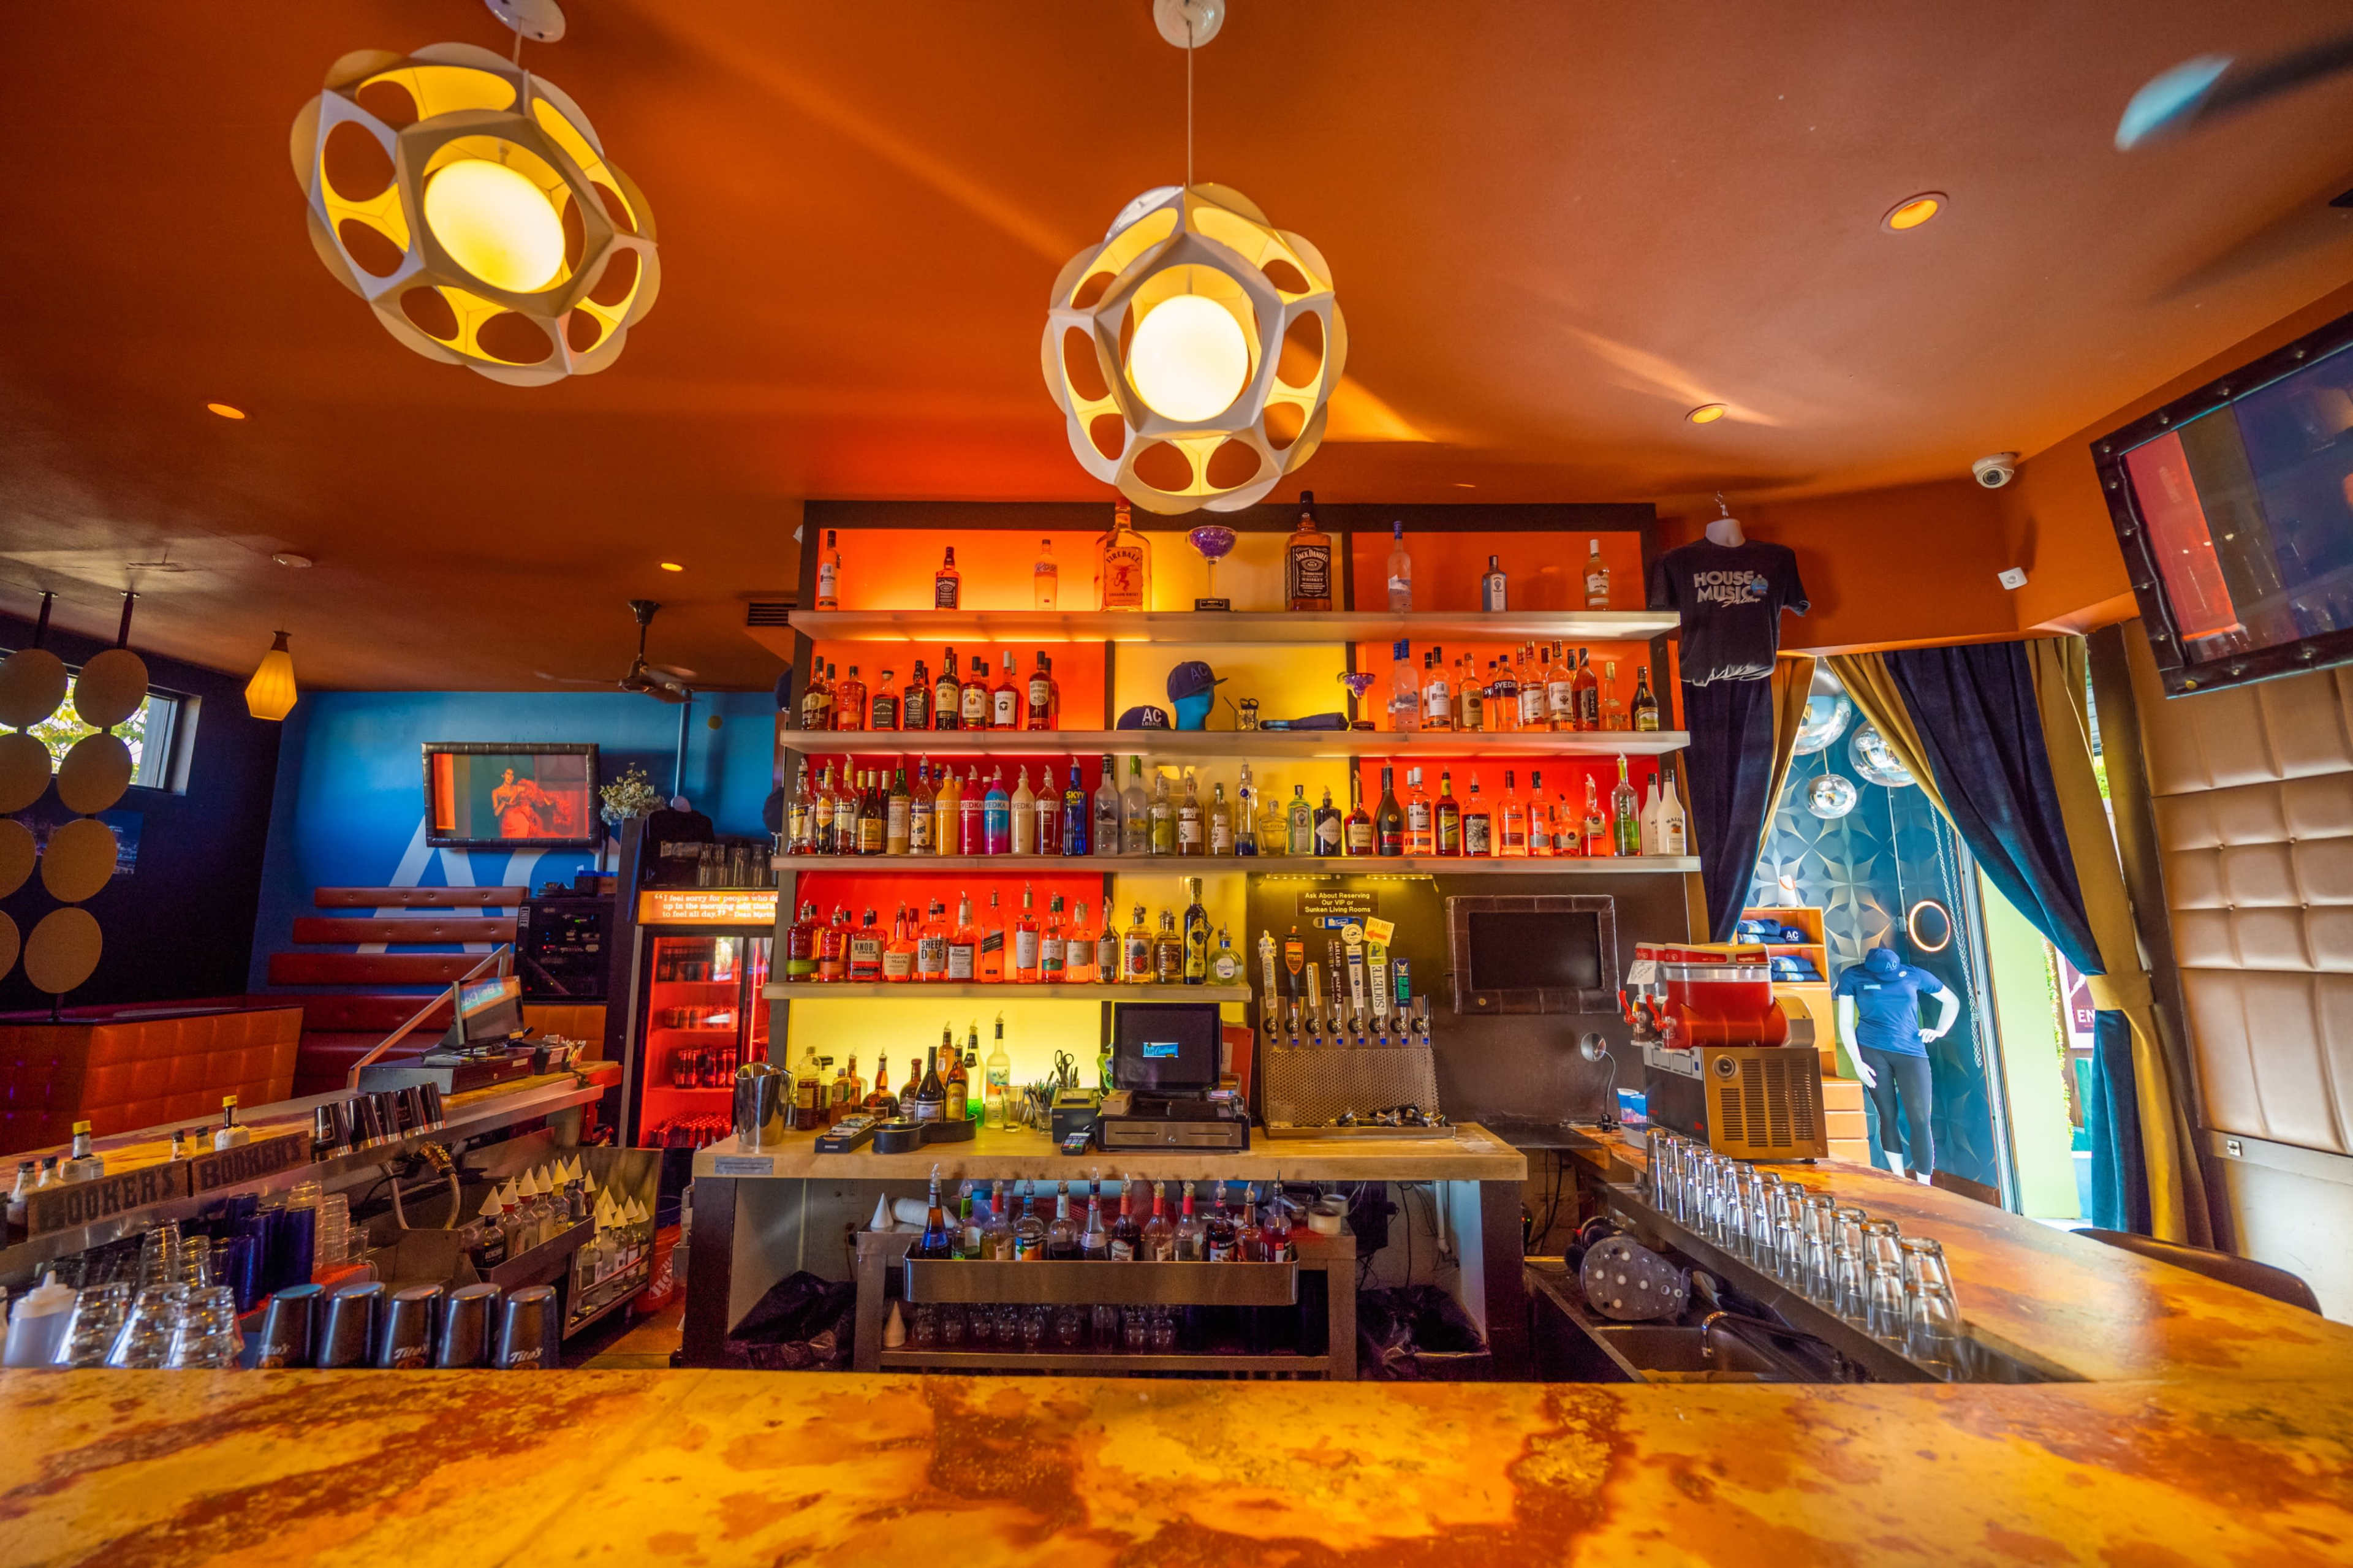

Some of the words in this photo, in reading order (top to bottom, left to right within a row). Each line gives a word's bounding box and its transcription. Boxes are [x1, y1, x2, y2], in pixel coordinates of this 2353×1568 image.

[1106, 550, 1140, 564] FIREBALL
[1295, 551, 1309, 562] JACK
[1693, 570, 1754, 588] HOUSE
[1697, 585, 1754, 603] MUSIC
[1191, 664, 1208, 681] AC
[1143, 708, 1162, 722] AC
[1066, 790, 1085, 799] SKYY
[1786, 931, 1799, 939] AC
[922, 941, 943, 949] SHEEP
[1885, 961, 1897, 970] AC
[1372, 966, 1386, 1009] SOCIETE
[39, 1167, 175, 1231] OOKER'S
[393, 1344, 428, 1360] Tito's
[510, 1347, 544, 1362] Tito's
